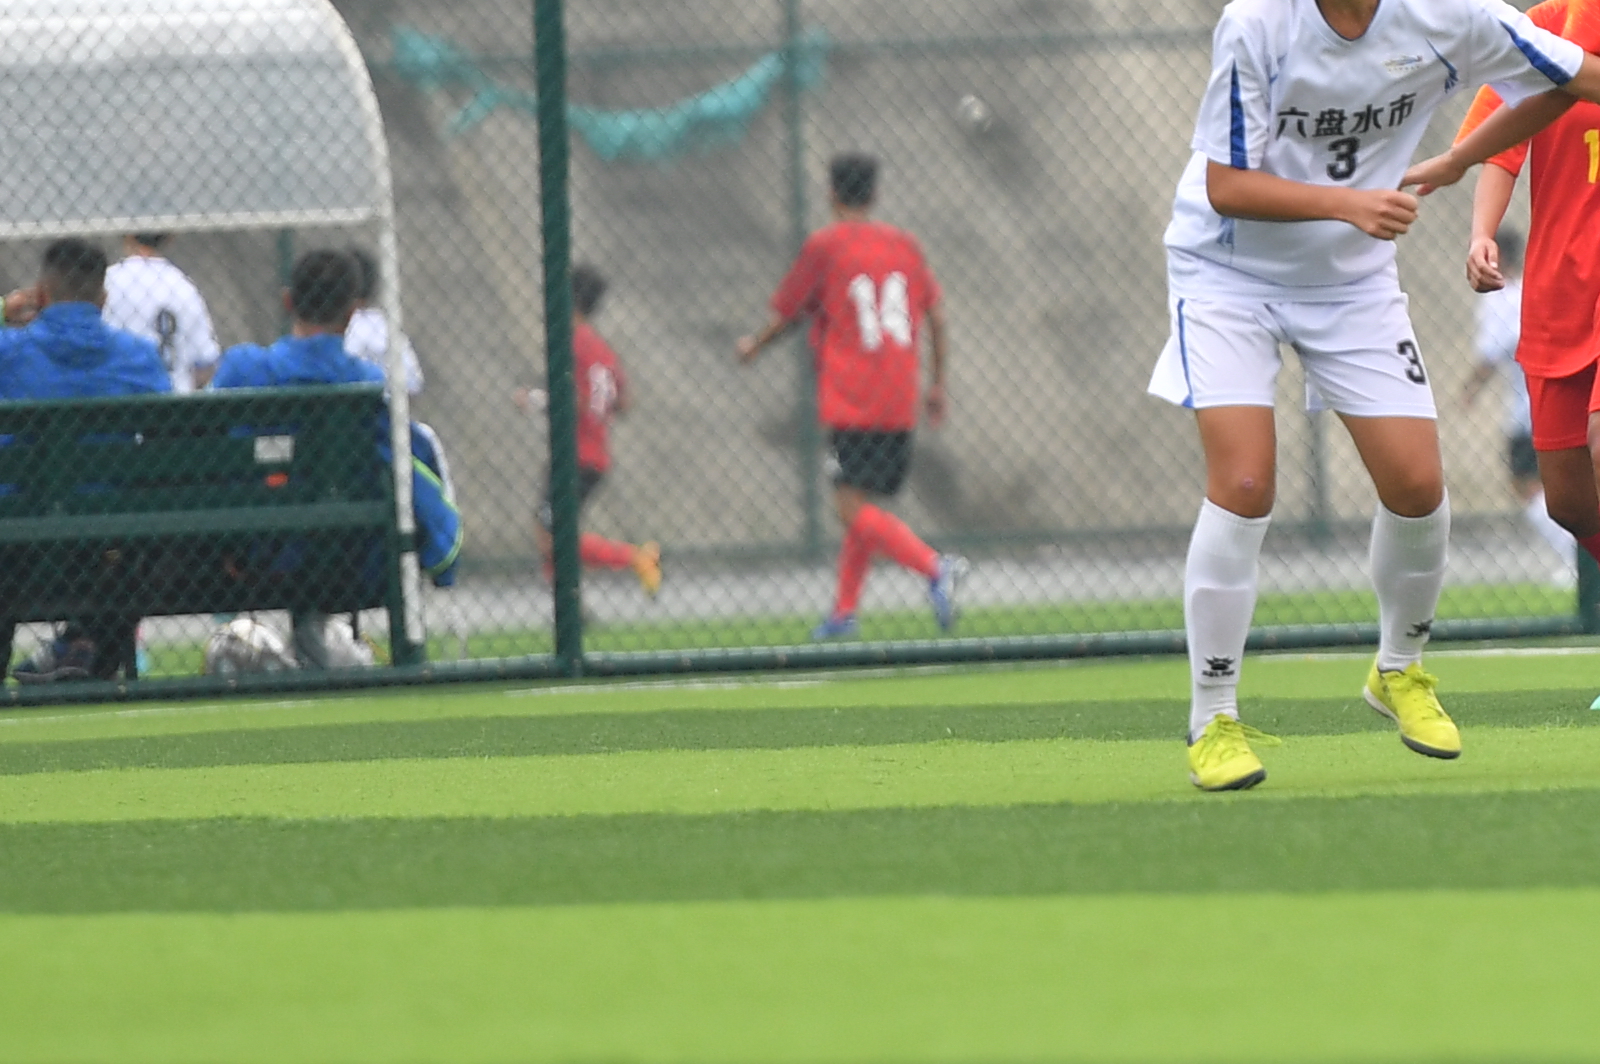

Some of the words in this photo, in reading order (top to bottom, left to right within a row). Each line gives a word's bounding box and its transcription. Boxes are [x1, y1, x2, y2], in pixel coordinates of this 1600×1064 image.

[1275, 92, 1417, 141] 六盘水市
[1326, 137, 1360, 181] 3
[848, 271, 912, 350] 14
[1396, 338, 1427, 385] 3
